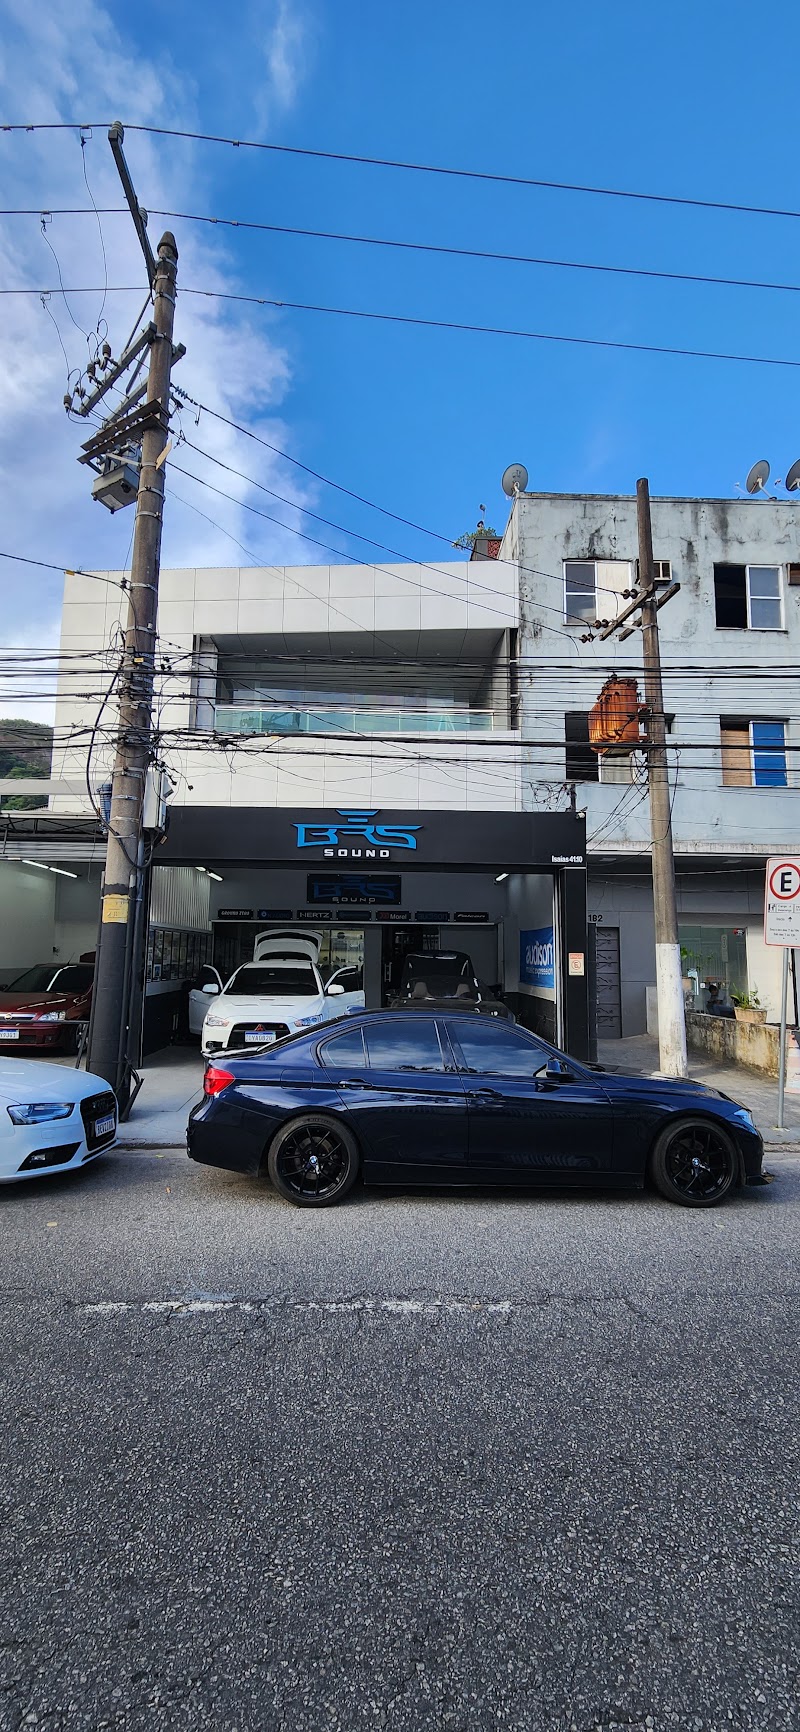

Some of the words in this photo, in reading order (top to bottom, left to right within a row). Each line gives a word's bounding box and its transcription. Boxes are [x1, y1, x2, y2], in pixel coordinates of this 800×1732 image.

[290, 822, 423, 849] BRS
[324, 849, 390, 858] SOUND
[780, 871, 792, 892] E
[525, 940, 553, 966] audison
